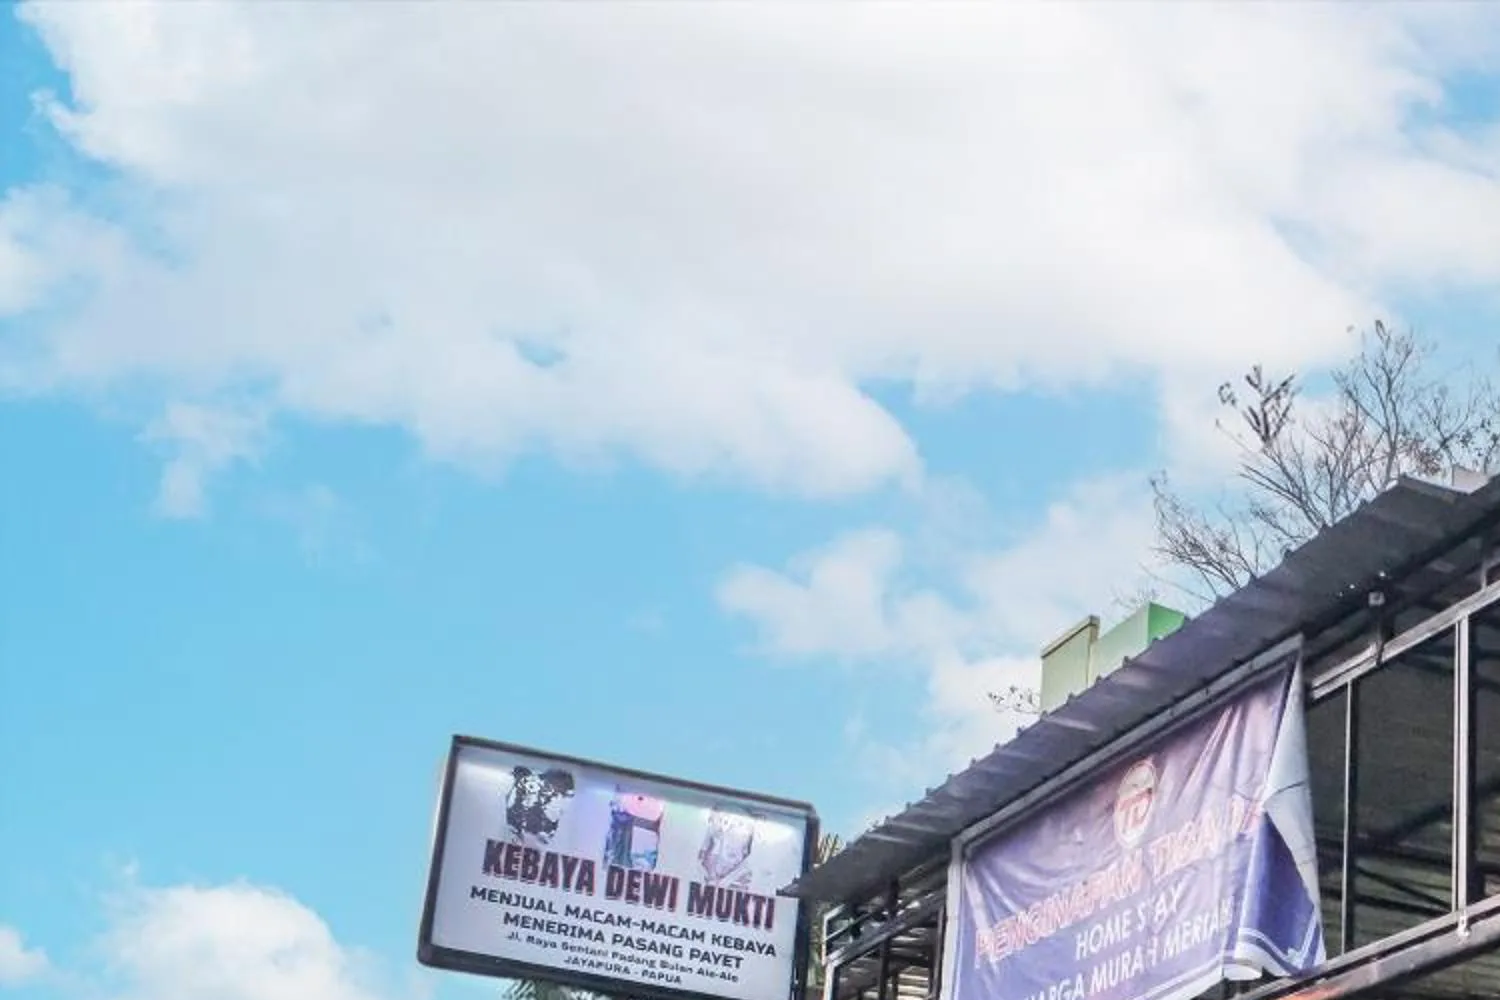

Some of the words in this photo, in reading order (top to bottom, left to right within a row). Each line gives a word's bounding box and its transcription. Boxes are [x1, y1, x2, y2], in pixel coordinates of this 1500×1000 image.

[482, 839, 596, 896] KEBAYA
[605, 864, 680, 912] DEWI
[687, 881, 776, 930] MUKTI
[470, 885, 558, 915] MENJUAL
[564, 903, 705, 944] MACAM-MACAM
[711, 929, 776, 957] KEBAYA
[503, 912, 605, 943] MENERIMA
[611, 933, 683, 959] PASANG
[689, 949, 744, 970] PAYET
[526, 935, 558, 950] Raya
[1075, 912, 1131, 961] HOME
[1135, 881, 1184, 931] SAY
[564, 958, 631, 976] JAYAPURA
[641, 968, 683, 985] PAPUA
